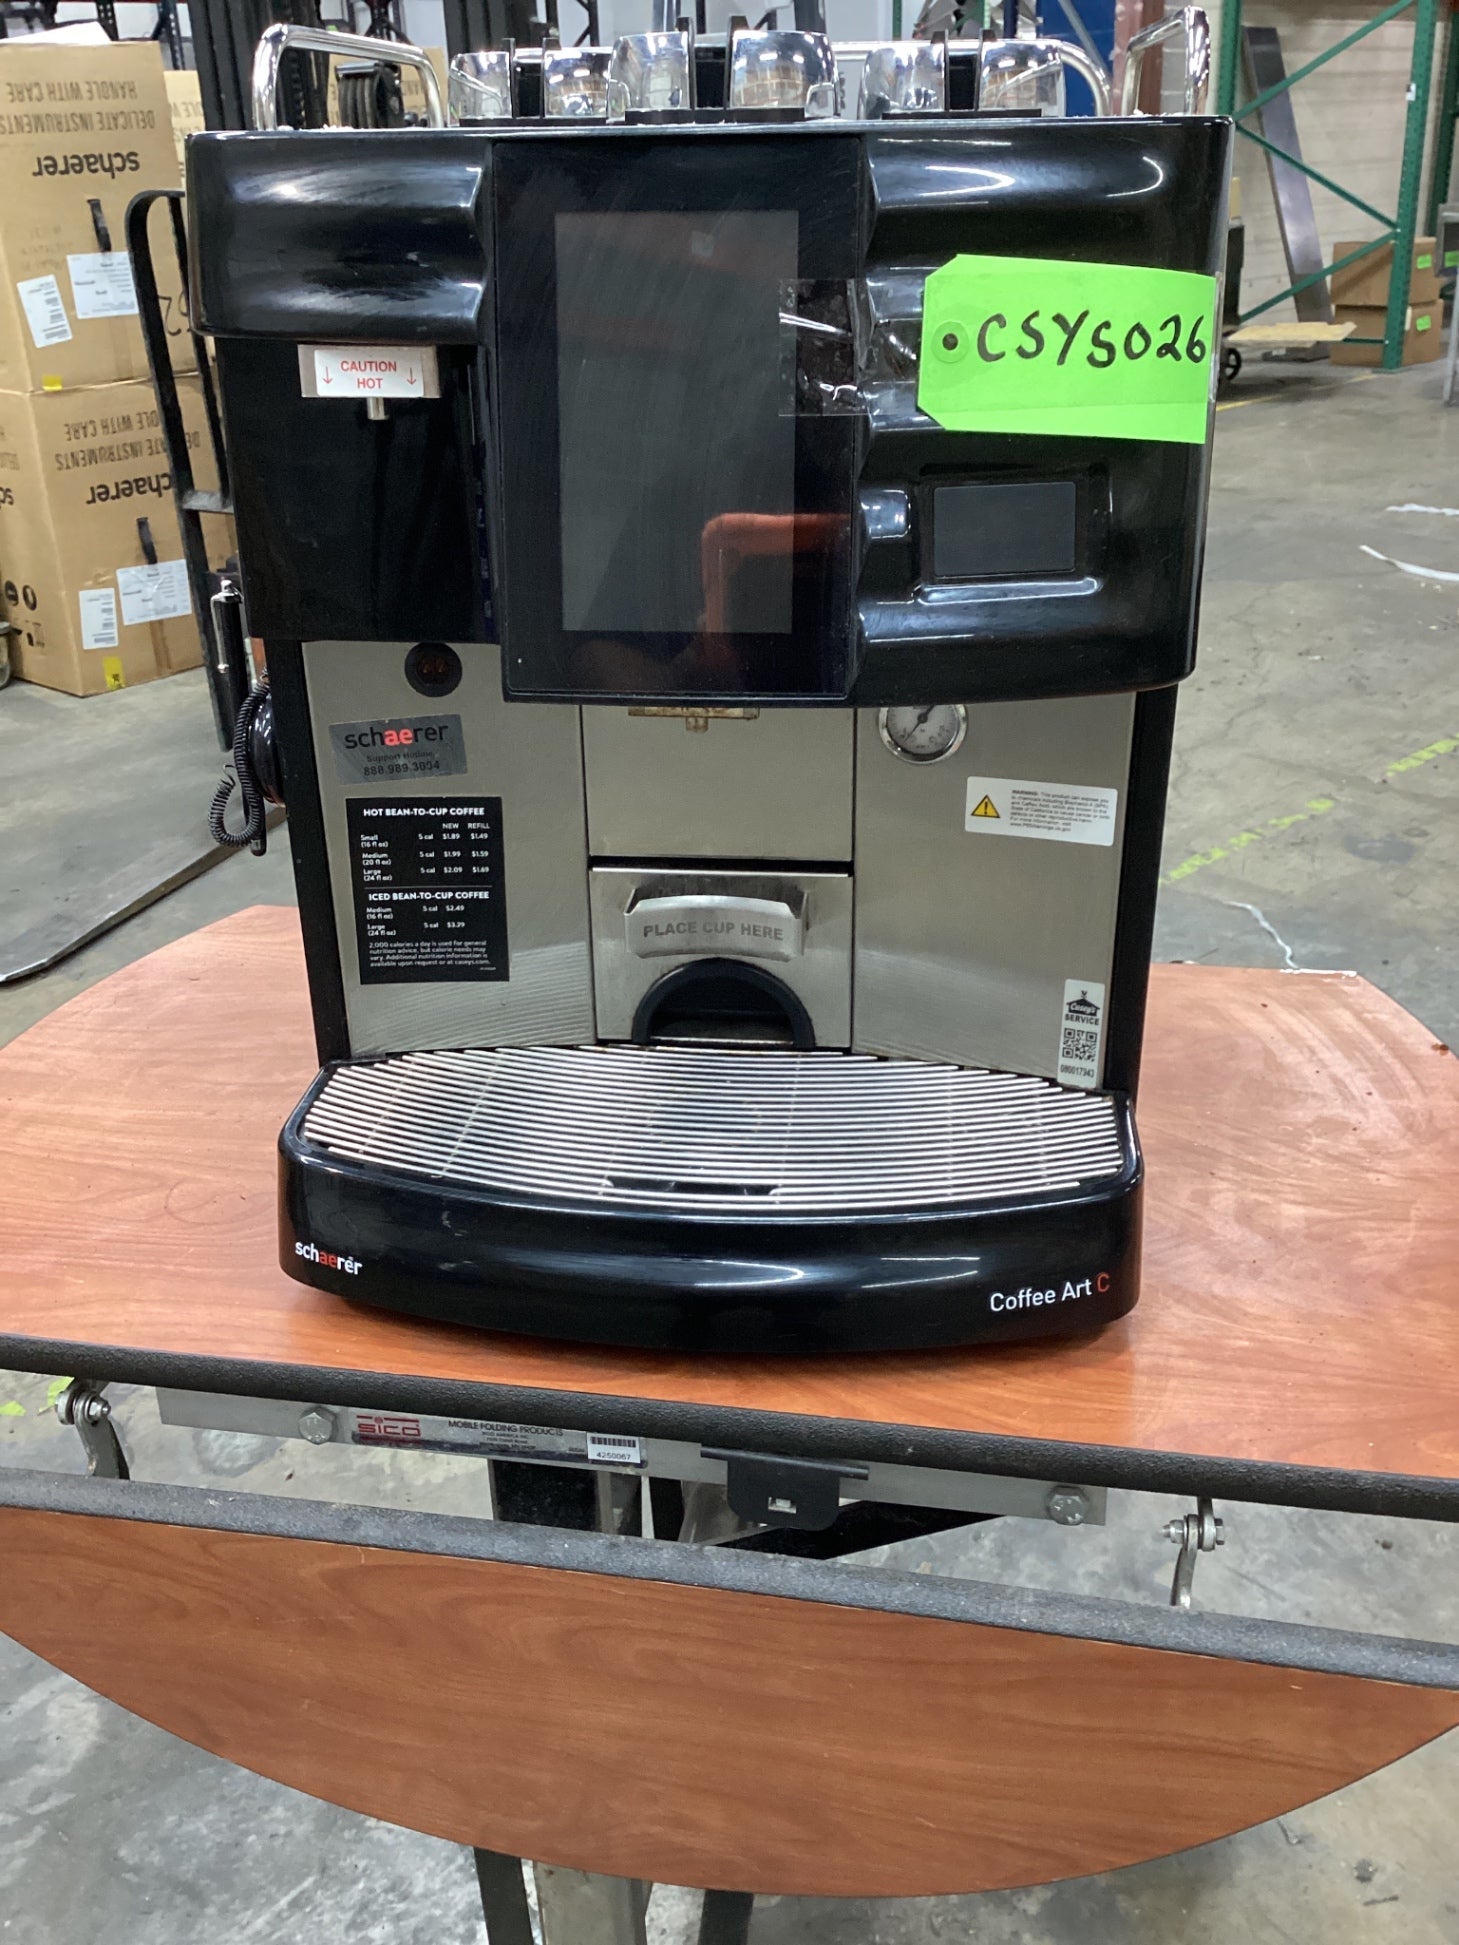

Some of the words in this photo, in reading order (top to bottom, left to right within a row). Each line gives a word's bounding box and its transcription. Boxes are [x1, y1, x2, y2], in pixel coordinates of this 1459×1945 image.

[6, 82, 44, 102] CARE
[46, 82, 82, 102] WITH
[86, 81, 138, 100] HANDLE
[96, 110, 155, 131] DELICATE
[32, 152, 140, 179] schaerer
[340, 360, 397, 372] CAUTION
[357, 378, 383, 389] HOT
[64, 420, 96, 441] CARE
[100, 414, 132, 435] WITH
[56, 442, 145, 471] INSTRUMENTS
[86, 473, 173, 504] chaerer
[344, 725, 448, 749] schaerer
[366, 753, 400, 762] Support
[363, 808, 383, 816] HOT
[385, 808, 448, 816] BEAN-TO-CUP
[450, 808, 485, 816] COFFEE
[392, 892, 453, 900] BEAN-TO-CUP
[644, 921, 698, 938] PLACE
[702, 922, 736, 934] CUP
[740, 923, 783, 941] HERE
[1065, 1014, 1100, 1025] SERVICE
[295, 1242, 363, 1275] schaerer
[990, 1287, 1056, 1312] Coffee
[1062, 1279, 1092, 1302] Art
[1097, 1272, 1110, 1292] C
[448, 1420, 479, 1429] MOBILE
[480, 1423, 517, 1432] FOLDING
[520, 1426, 563, 1436] PRODUCTS
